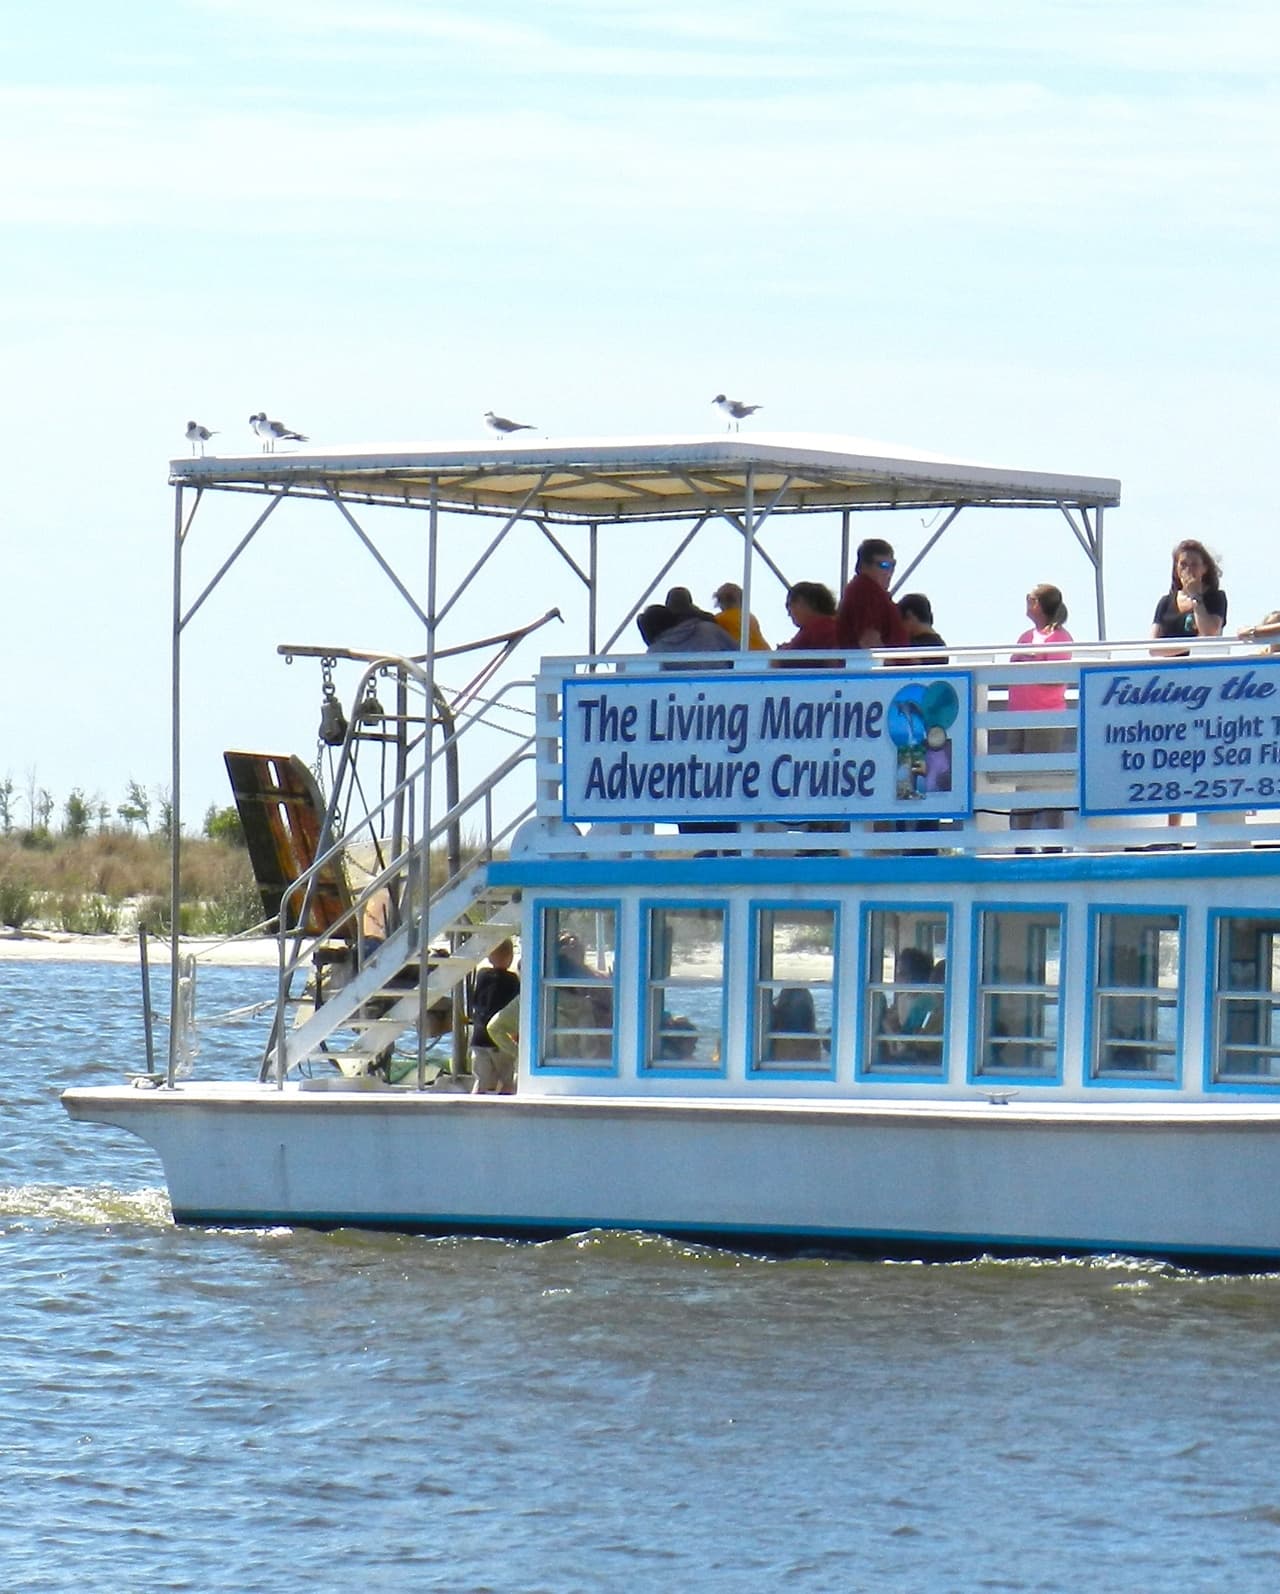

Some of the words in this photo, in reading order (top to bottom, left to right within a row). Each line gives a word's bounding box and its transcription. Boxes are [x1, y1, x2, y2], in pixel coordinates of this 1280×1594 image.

[1102, 676, 1211, 709] Fishing
[1221, 671, 1277, 700] the
[578, 694, 637, 742] The
[649, 693, 748, 753] Living
[760, 690, 882, 739] Marine
[1105, 720, 1187, 744] Inshore
[1194, 714, 1263, 743] "Light
[585, 751, 760, 799] Adventure
[771, 748, 876, 797] Cruise
[1121, 749, 1145, 771] to
[1152, 748, 1206, 773] Deep
[1213, 745, 1252, 766] Sea
